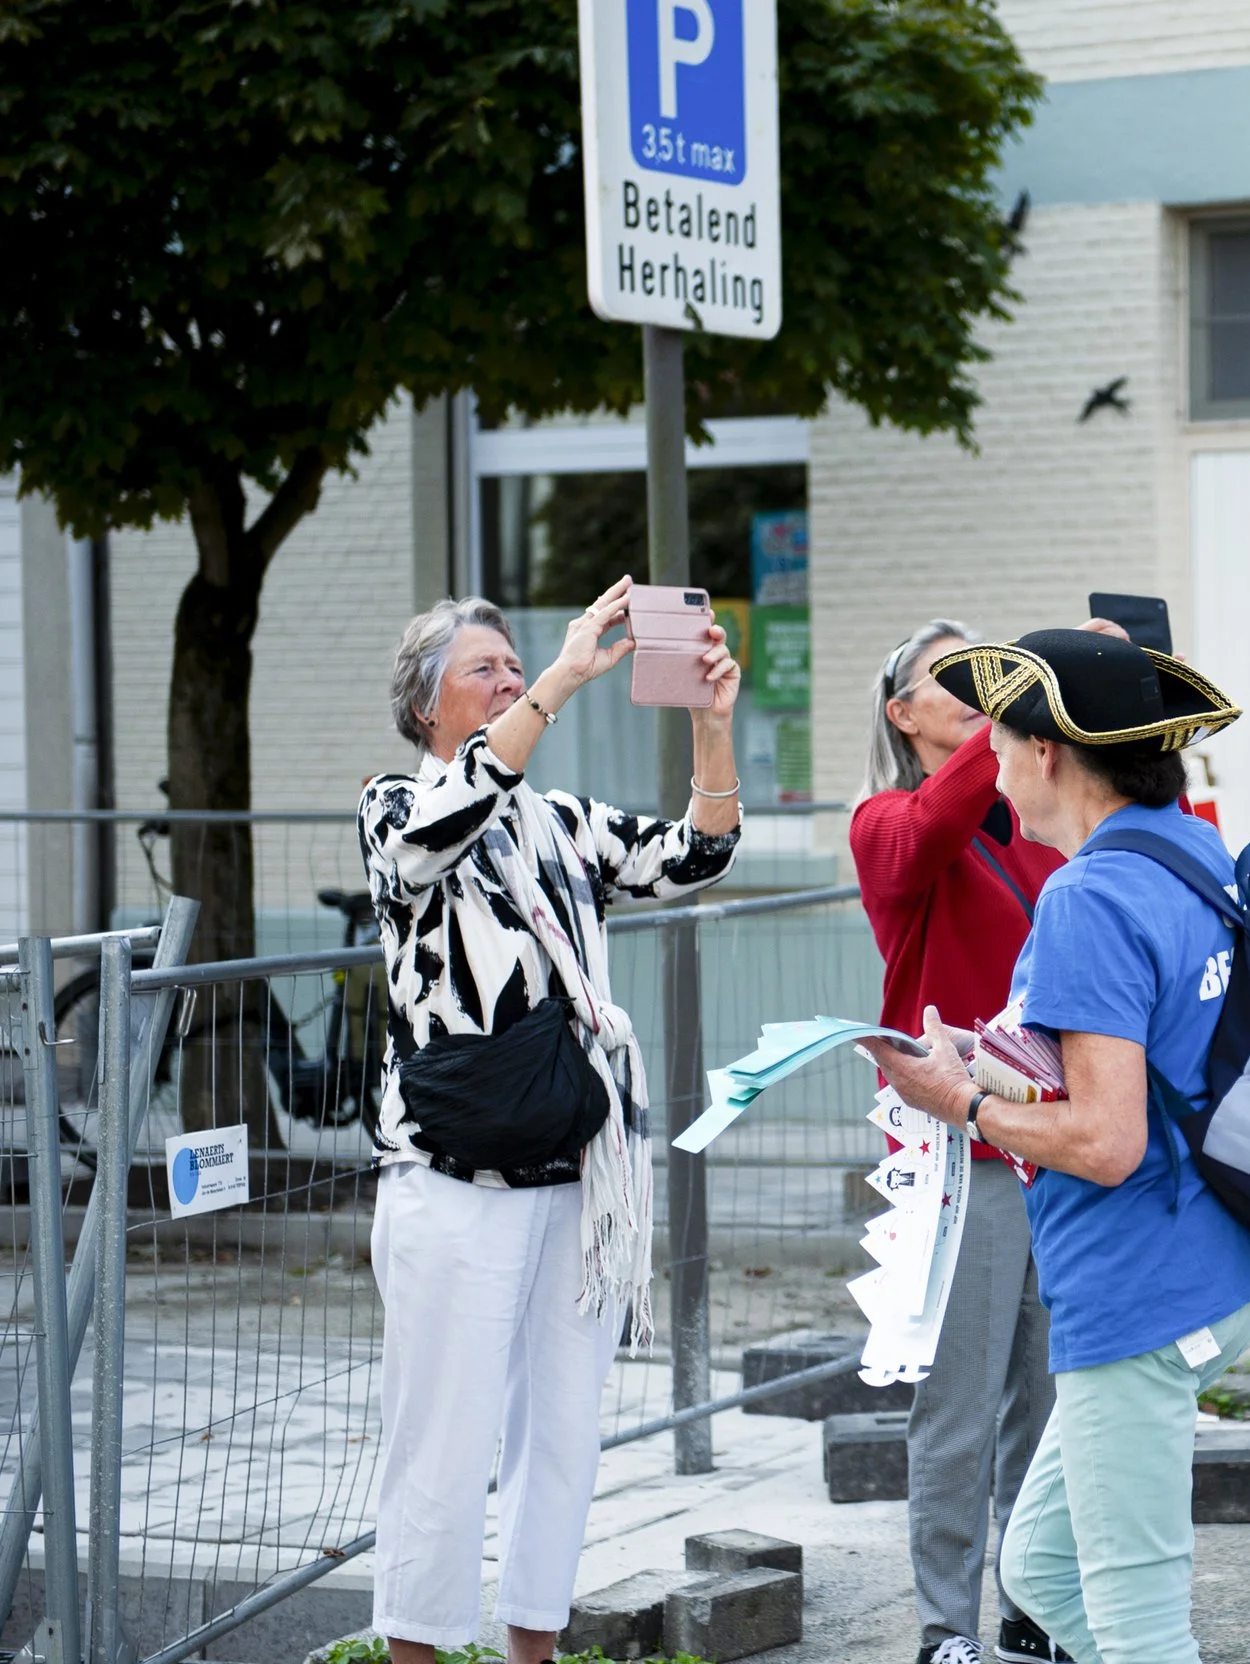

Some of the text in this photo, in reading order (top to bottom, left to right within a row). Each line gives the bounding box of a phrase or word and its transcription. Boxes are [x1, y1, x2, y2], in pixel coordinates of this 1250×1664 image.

[656, 0, 715, 119] P
[691, 142, 736, 174] max
[622, 180, 758, 250] Betalend
[617, 243, 764, 325] Herhaling
[189, 1143, 225, 1160] LENAERTS
[189, 1152, 234, 1171] BLOMMAERT
